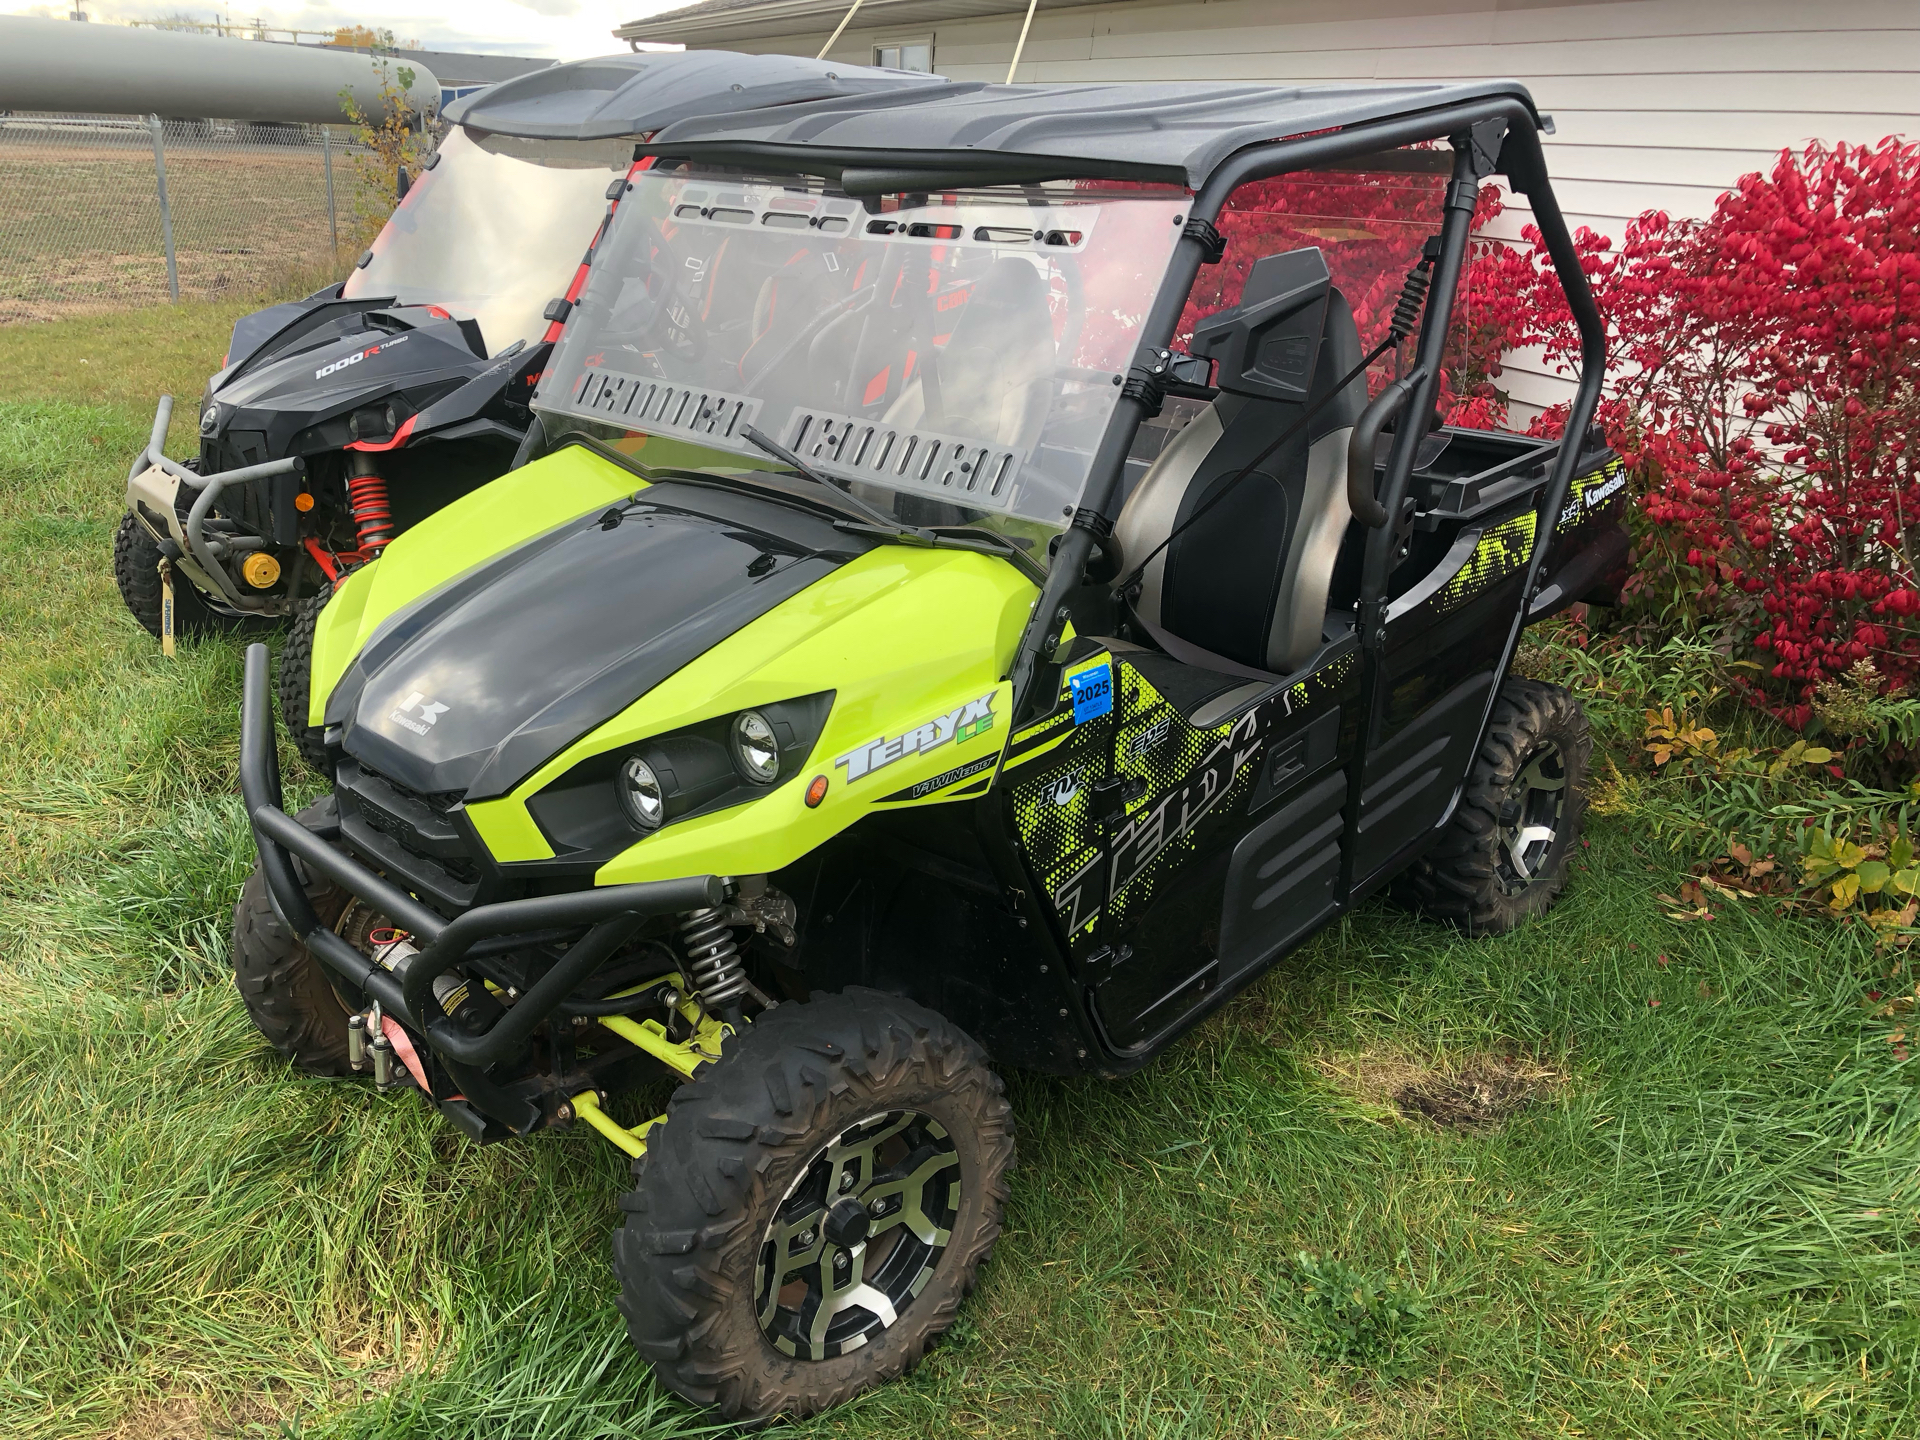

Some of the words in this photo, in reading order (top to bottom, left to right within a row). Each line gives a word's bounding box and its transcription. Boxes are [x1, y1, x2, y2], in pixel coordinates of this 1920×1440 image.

[315, 345, 381, 380] 1000R
[380, 335, 409, 350] TURBO
[1585, 468, 1626, 508] Kawasaki
[1076, 680, 1110, 705] 2025
[388, 709, 432, 737] Kawasaki
[834, 689, 999, 785] TERYX
[956, 711, 998, 745] LE
[1128, 717, 1171, 756] EPS
[1038, 765, 1085, 808] FOX
